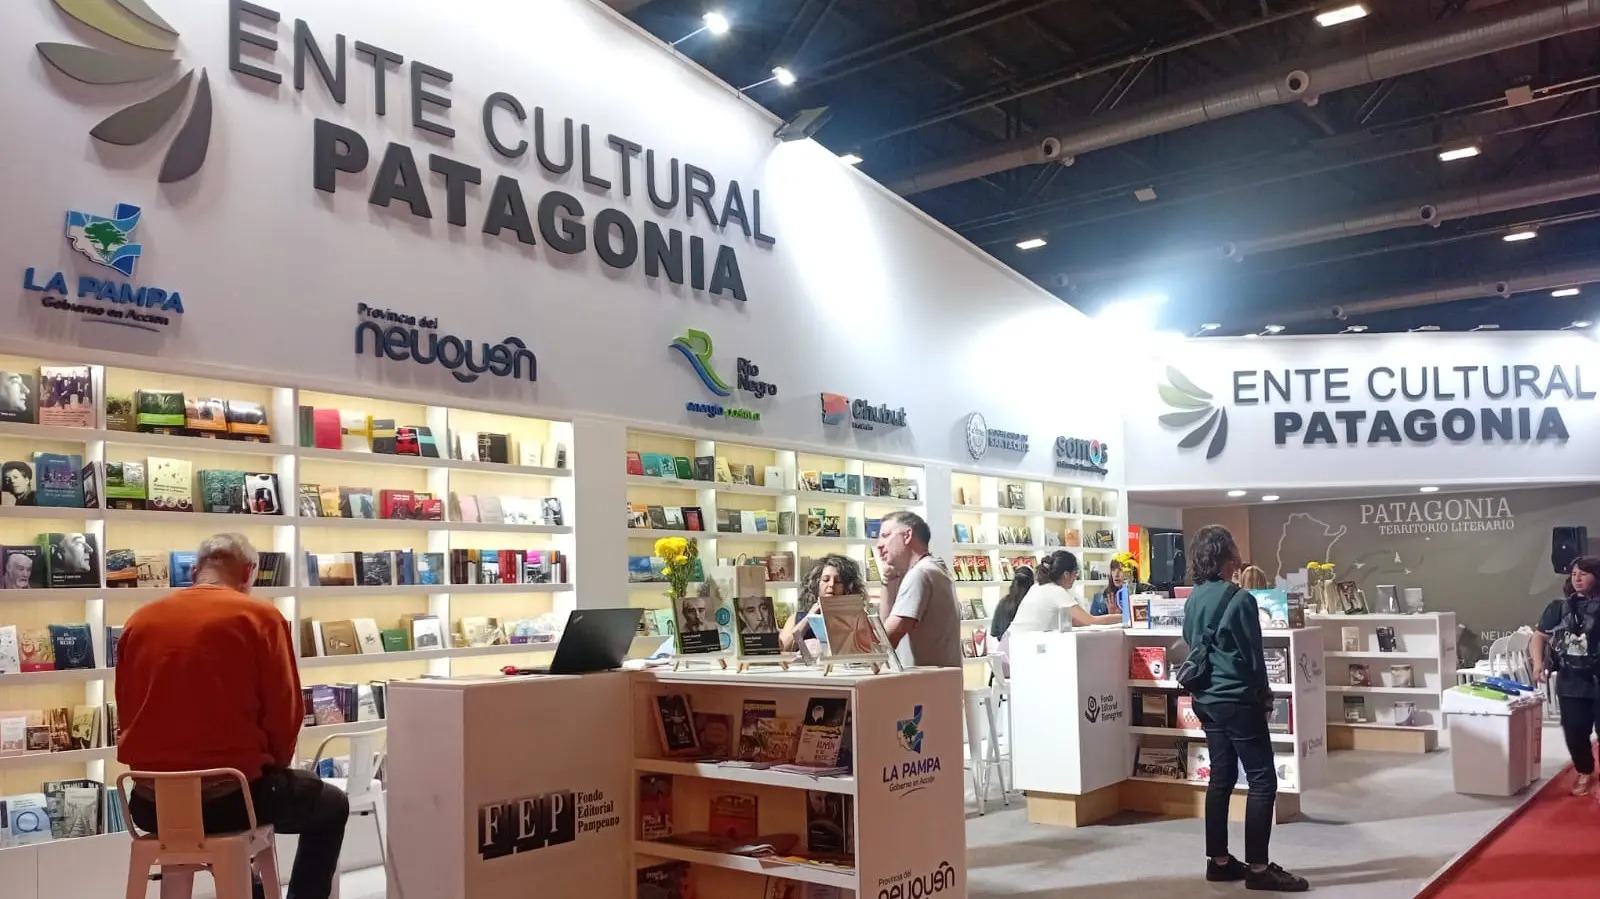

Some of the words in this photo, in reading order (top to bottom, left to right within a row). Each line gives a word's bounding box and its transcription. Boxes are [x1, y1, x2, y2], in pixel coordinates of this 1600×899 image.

[229, 0, 456, 138] ENTE
[482, 91, 776, 246] CULTURAL
[313, 117, 748, 302] PATAGONIA
[24, 266, 69, 295] LA
[77, 276, 185, 314] PAMPA
[357, 302, 417, 326] Provincia
[418, 316, 439, 329] del
[737, 372, 778, 399] Negro
[1233, 368, 1351, 403] ENTE
[1367, 364, 1597, 401] CULTURAL
[851, 398, 907, 428] Chubut
[1274, 406, 1570, 445] PATAGONIA
[1360, 496, 1514, 525] PATAGONIA
[1378, 522, 1449, 536] TERRITORIO
[1451, 519, 1515, 533] LITERARIO
[882, 765, 899, 783] LA
[902, 756, 942, 779] PAMPA
[577, 789, 604, 805] Fondo
[577, 801, 614, 819] Editorial
[577, 815, 620, 834] Pampeano
[878, 873, 903, 887] Provincia
[903, 868, 912, 880] del
